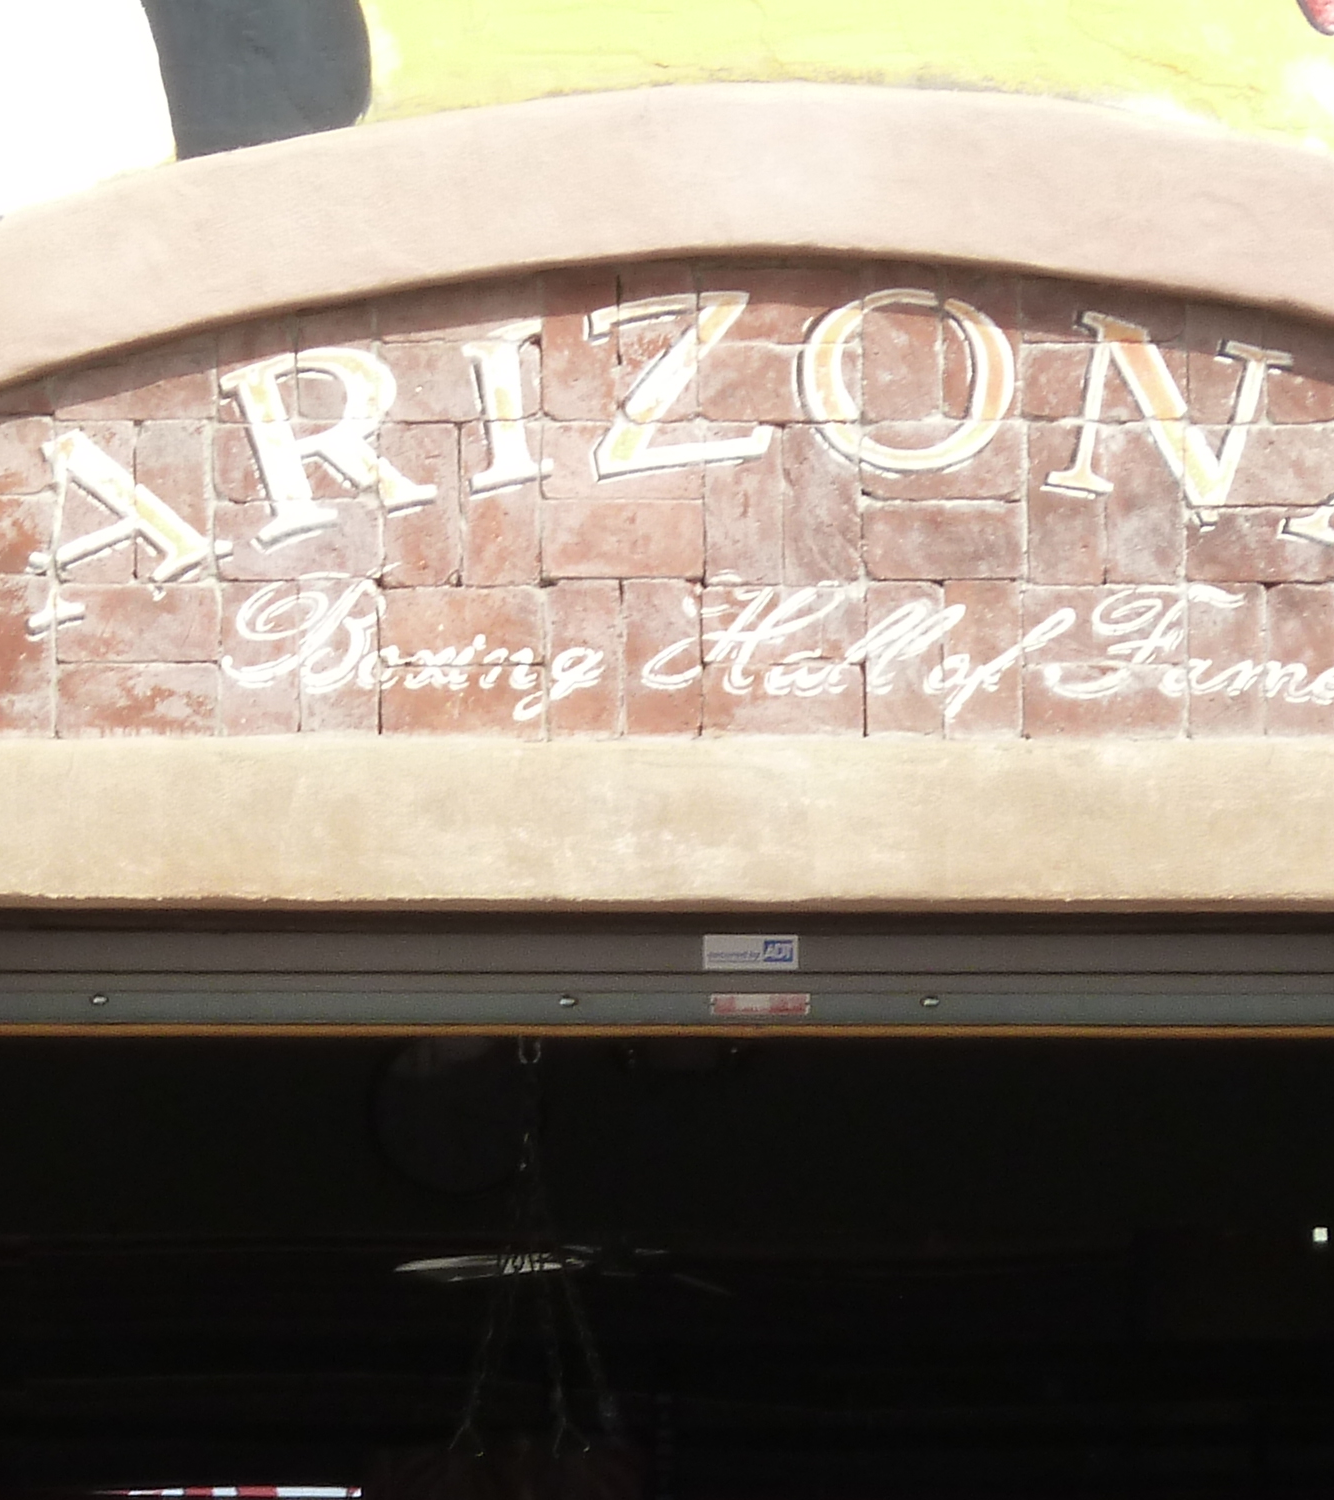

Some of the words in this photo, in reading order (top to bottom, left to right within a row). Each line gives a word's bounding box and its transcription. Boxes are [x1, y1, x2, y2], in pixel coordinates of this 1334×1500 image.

[223, 562, 604, 721] Boxing
[642, 570, 965, 699] Hall
[924, 607, 1076, 723] of
